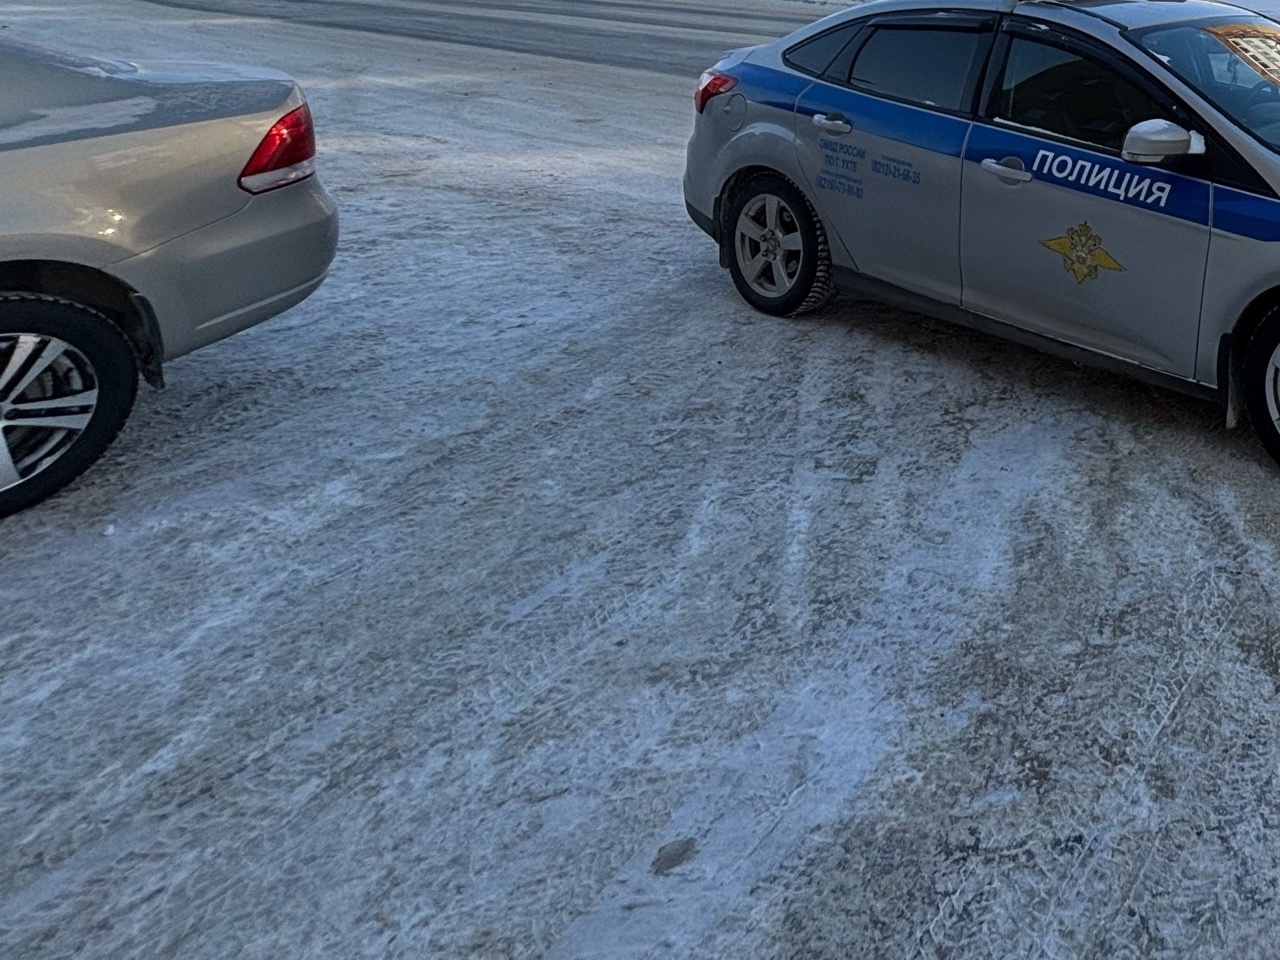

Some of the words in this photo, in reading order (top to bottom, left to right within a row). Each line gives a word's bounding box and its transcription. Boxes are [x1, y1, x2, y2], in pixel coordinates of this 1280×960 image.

[839, 143, 866, 160] РОССИИ
[824, 154, 834, 167] ПО
[841, 159, 858, 173] УХТЕ
[1032, 149, 1172, 208] ПОЛИЦИЯ
